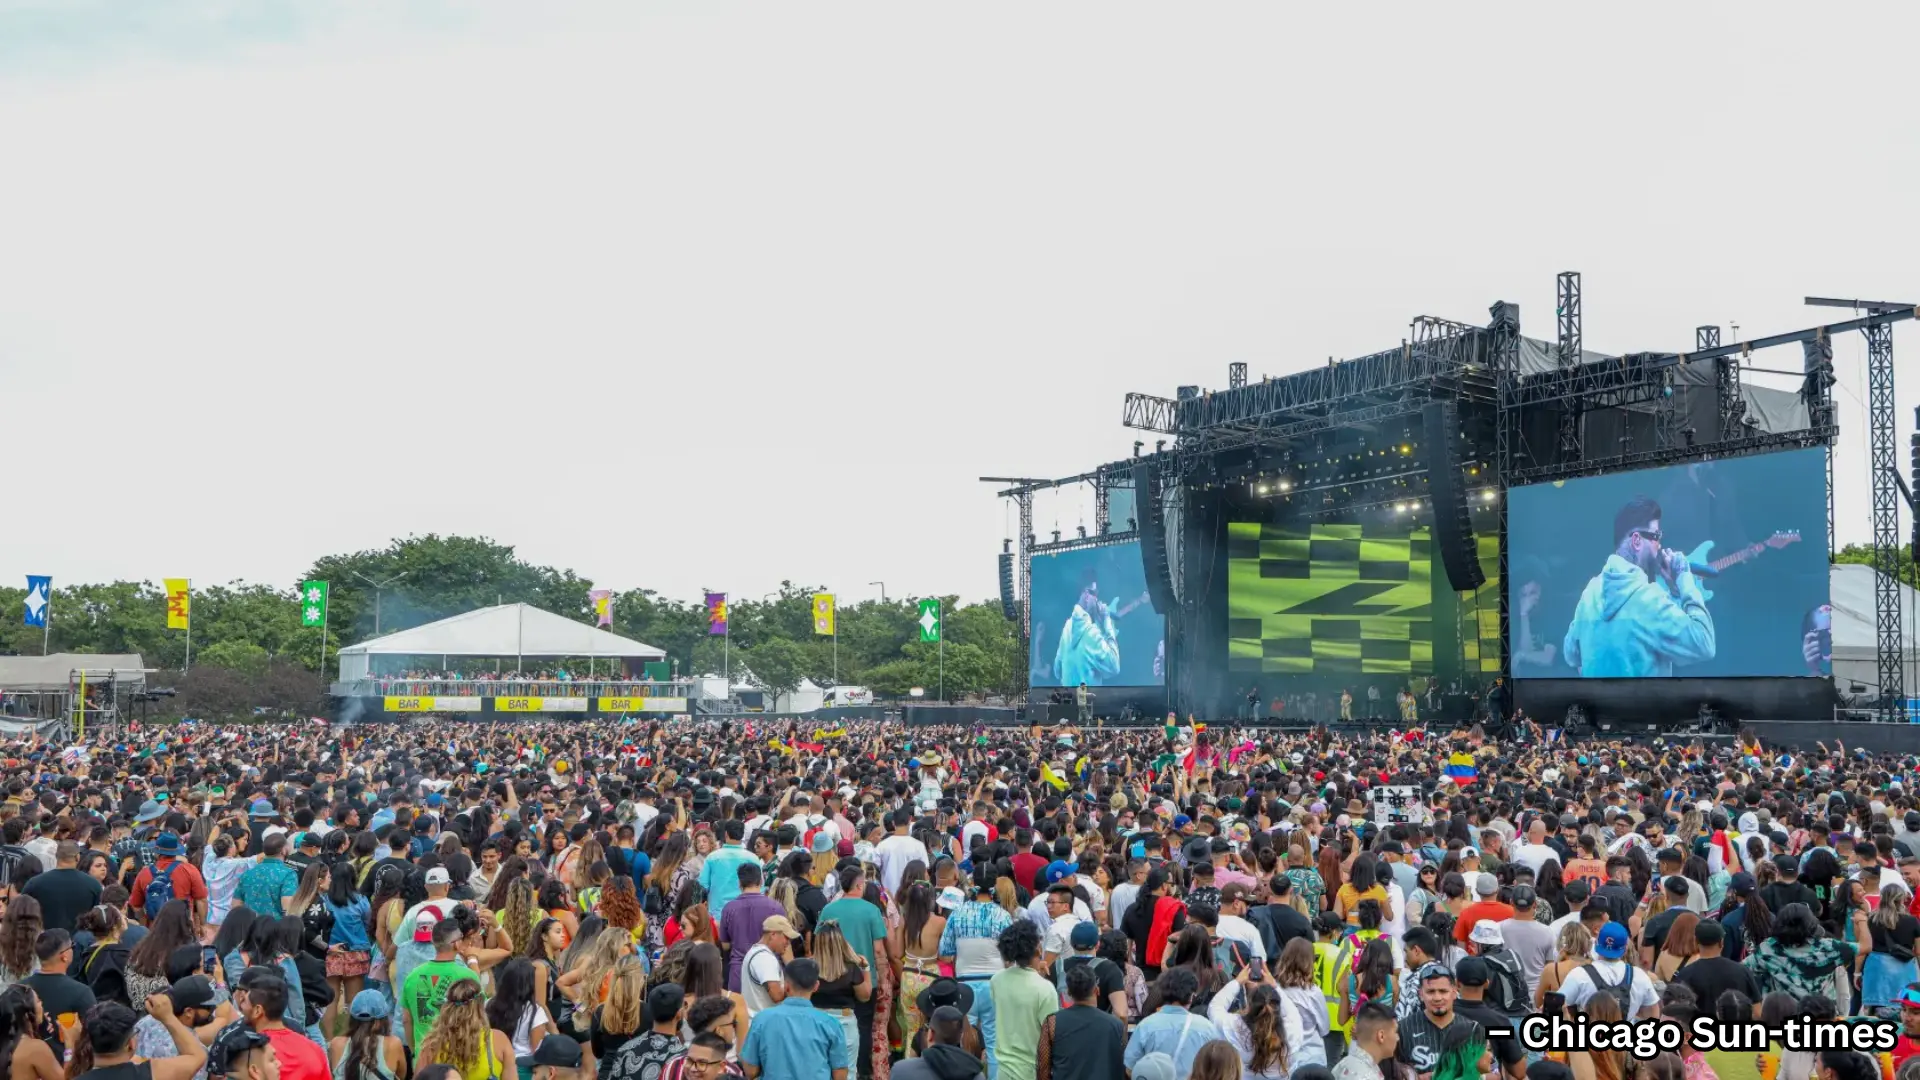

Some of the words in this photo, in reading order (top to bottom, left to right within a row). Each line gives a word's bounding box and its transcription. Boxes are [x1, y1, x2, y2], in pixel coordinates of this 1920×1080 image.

[398, 699, 420, 709] BAR
[507, 699, 529, 709] BAR
[611, 699, 631, 709] BAR
